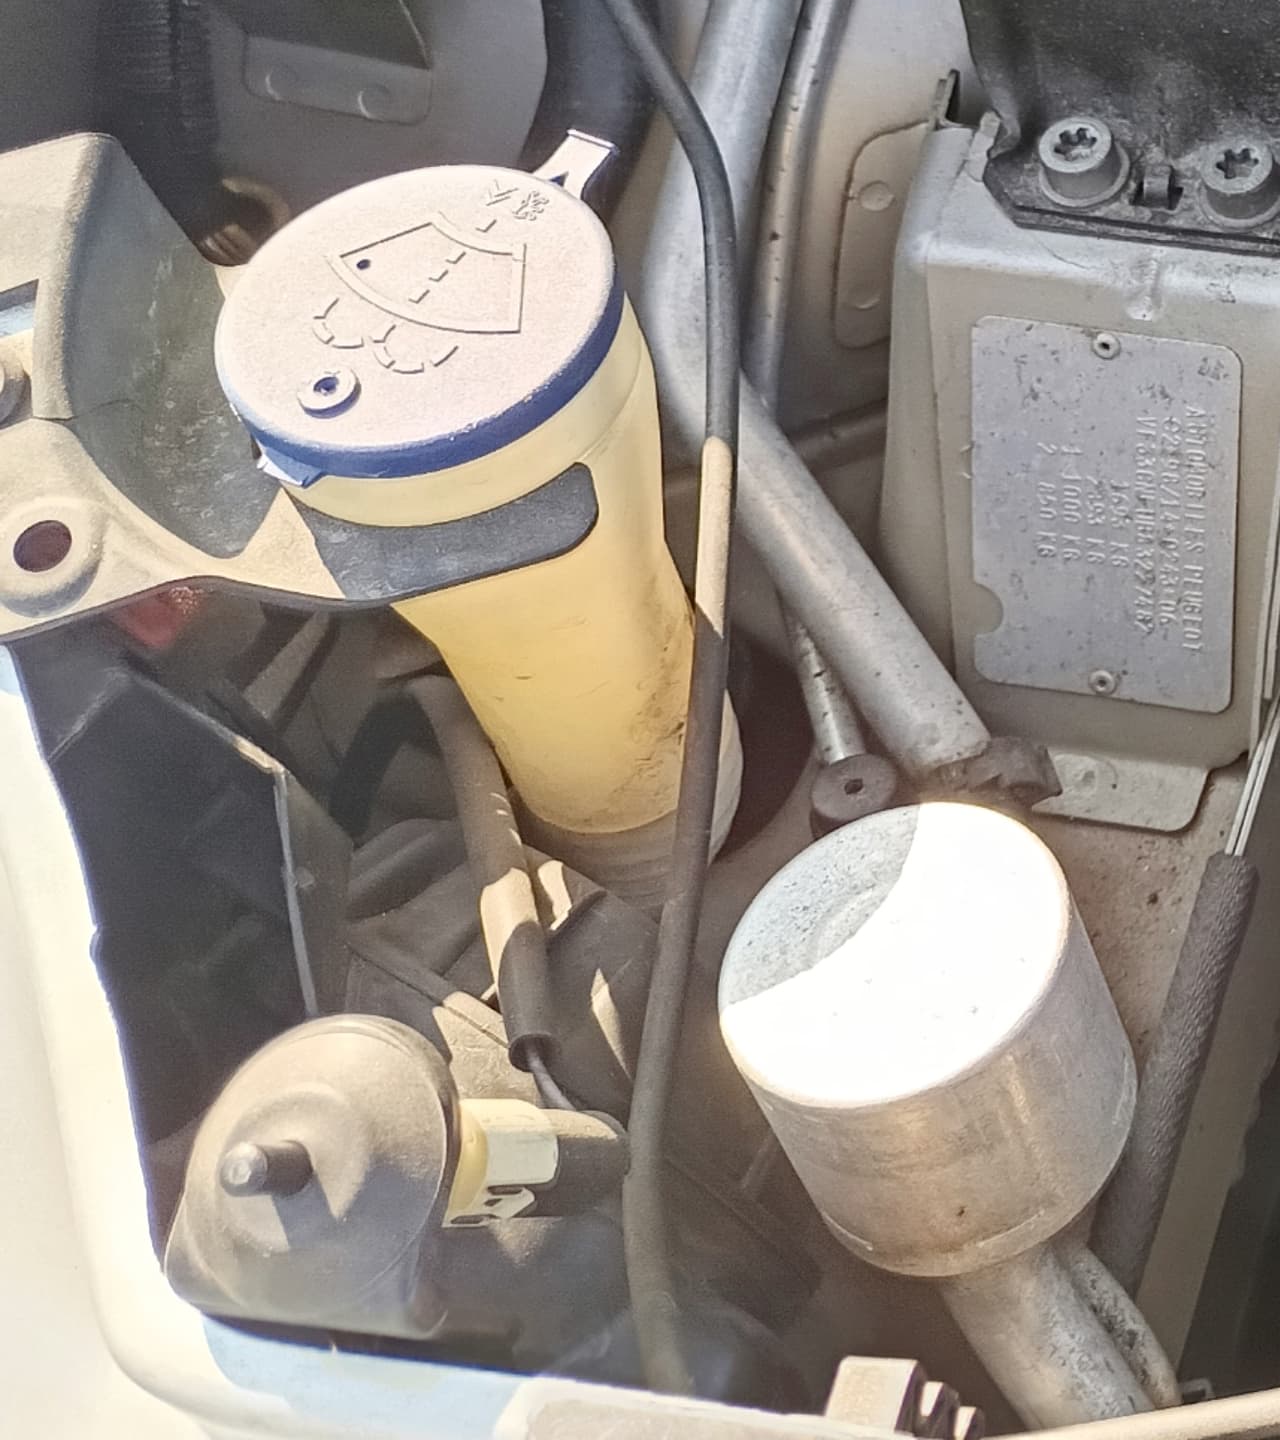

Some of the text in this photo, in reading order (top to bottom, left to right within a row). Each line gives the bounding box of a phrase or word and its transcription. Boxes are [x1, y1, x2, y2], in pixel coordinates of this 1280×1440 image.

[1062, 474, 1084, 523] 1000
[1108, 479, 1131, 568] 1693 KG
[1036, 530, 1058, 558] KG
[1061, 534, 1082, 560] KG
[1085, 536, 1106, 564] KG
[1182, 564, 1205, 650] PEUGEOT
